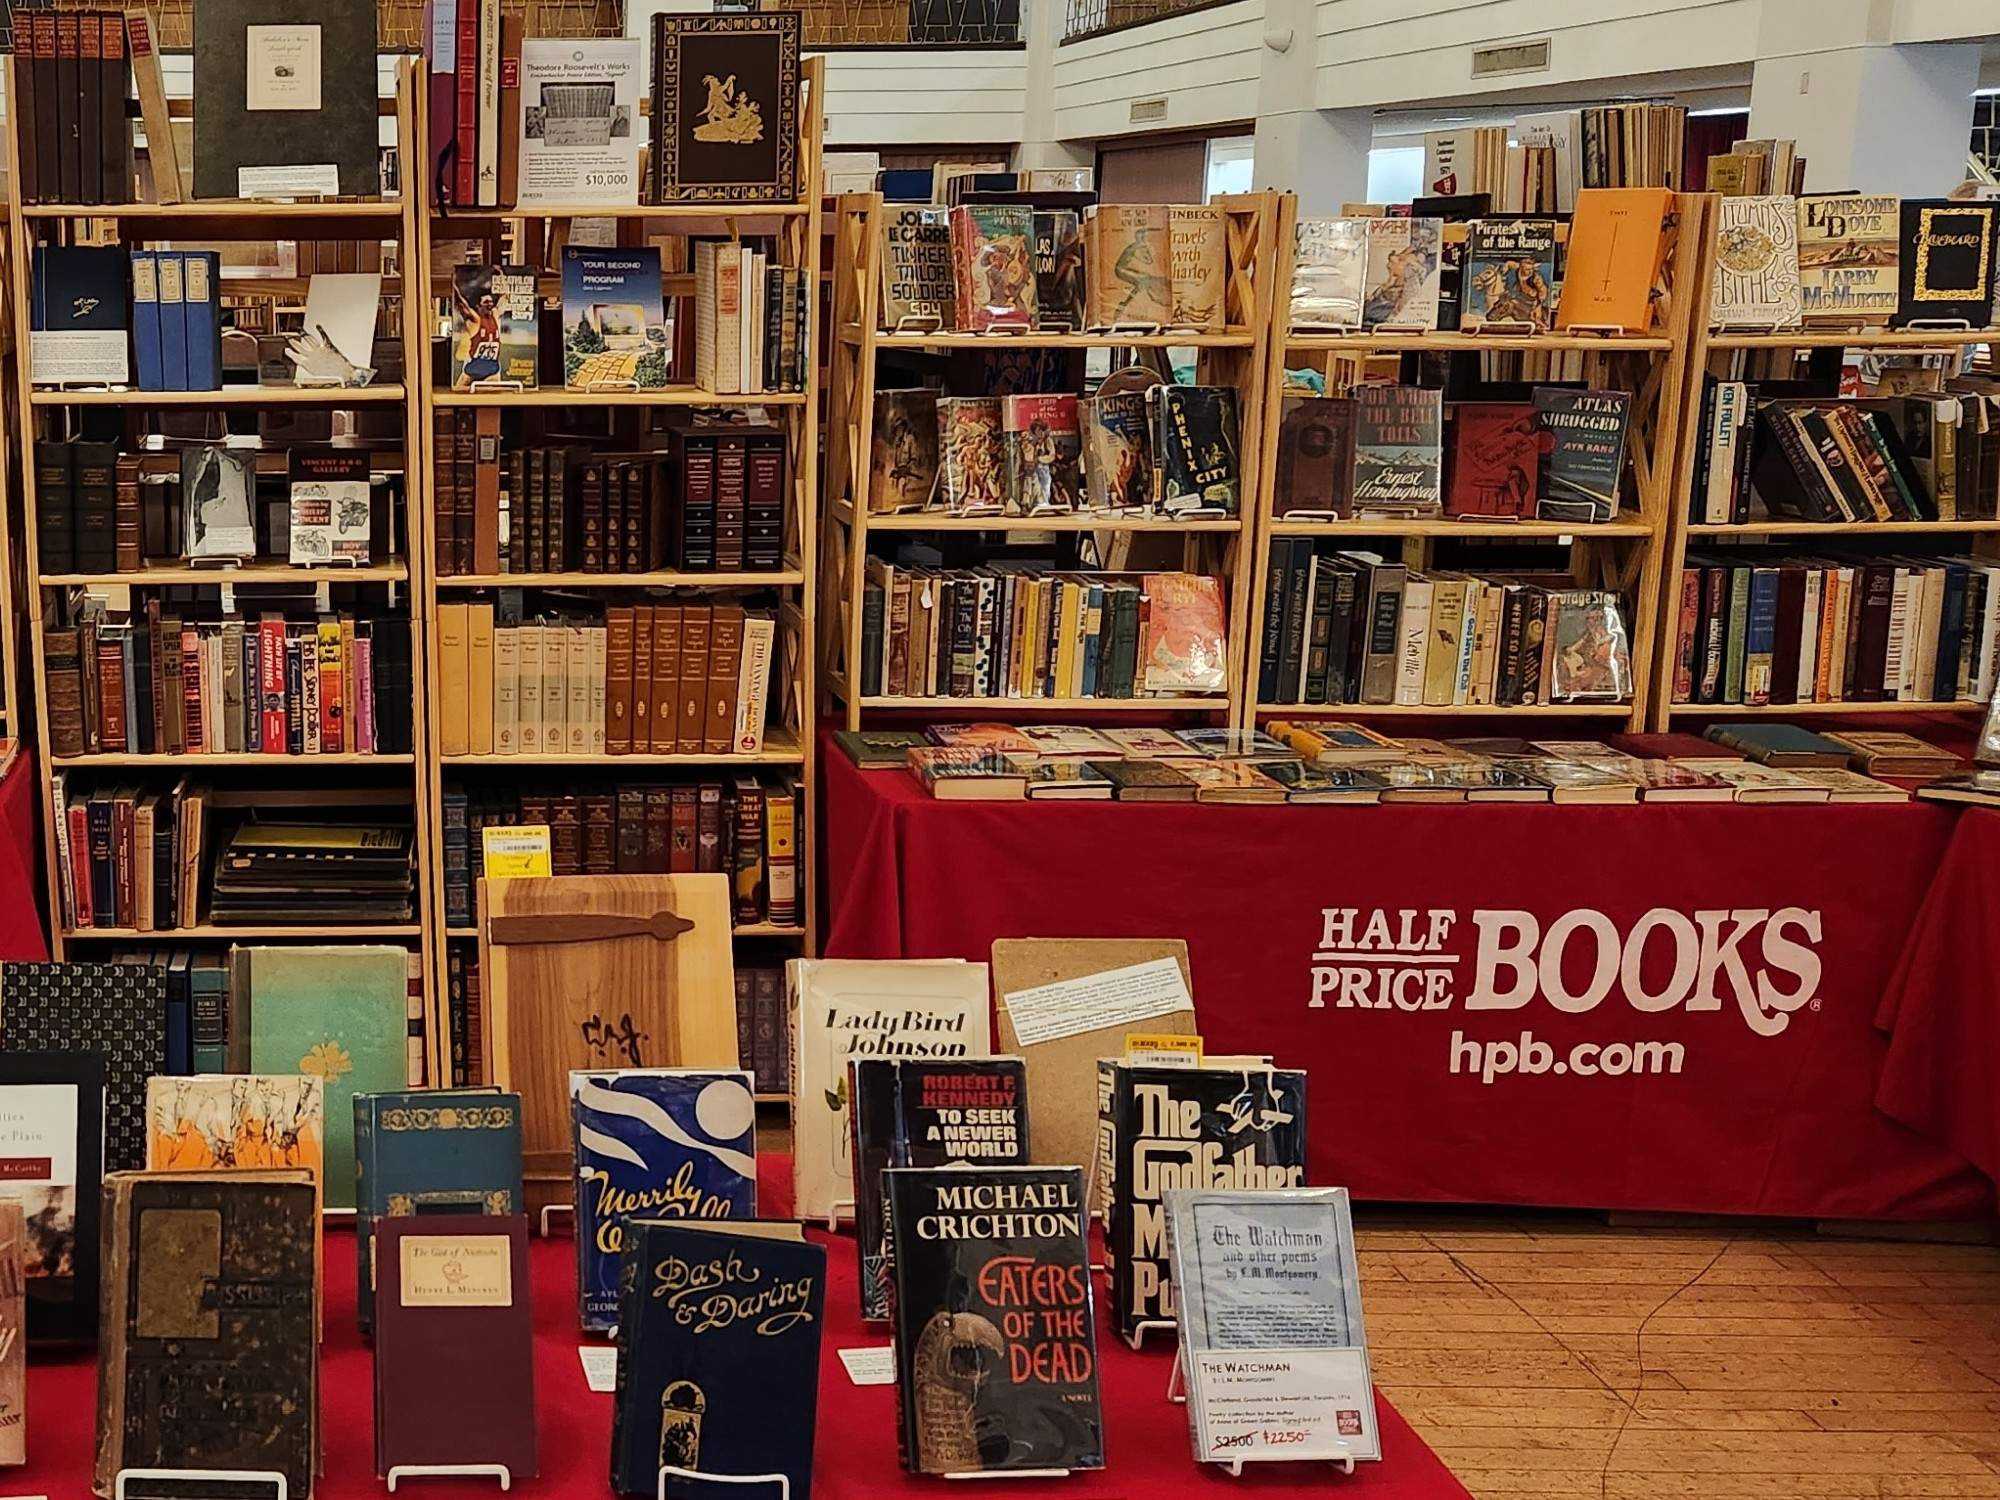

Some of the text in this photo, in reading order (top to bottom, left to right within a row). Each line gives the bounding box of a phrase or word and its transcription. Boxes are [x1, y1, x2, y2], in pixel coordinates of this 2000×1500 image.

[527, 63, 562, 71] Theodore
[563, 63, 605, 71] Roosevelt's
[585, 174, 628, 186] $10,000
[1805, 198, 1896, 228] LONESOME
[1172, 228, 1208, 244] ravels
[1475, 223, 1511, 236] Pirates
[1819, 214, 1882, 239] DOVE
[1482, 236, 1552, 251] of the Range
[583, 261, 641, 269] YOUR SECOND
[1172, 262, 1212, 283] harley
[583, 276, 625, 284] PROGRAM
[1822, 269, 1878, 290] LARRY
[892, 283, 956, 301] SOLDIER
[1571, 396, 1623, 413] ATLAS
[1365, 407, 1391, 424] THE
[1540, 412, 1621, 432] SHRUGGED
[1718, 386, 1735, 449] KEN FOLLETT
[1171, 402, 1199, 472] PHENIX
[1376, 425, 1423, 443] TOLLS
[1563, 442, 1585, 450] AYN
[1195, 466, 1229, 485] CITY
[1374, 466, 1424, 485] Ernest
[1353, 479, 1438, 502] Hemingway
[1273, 568, 1283, 588] Gone
[1269, 608, 1279, 623] the
[1466, 617, 1475, 637] God
[275, 636, 283, 657] PATH
[1464, 637, 1474, 659] Save
[1507, 602, 1522, 678] NEVER SO FEW
[263, 628, 274, 689] LIGHTNING
[1404, 627, 1423, 678] Melville
[1462, 659, 1472, 674] the
[304, 675, 319, 706] SIDNEY
[739, 804, 762, 813] GREAT
[743, 796, 758, 804] THE
[741, 813, 759, 821] WAR
[1318, 908, 1456, 950] HALF
[1465, 907, 1822, 1037] BOOKS
[1308, 967, 1454, 1011] PRICE
[824, 1008, 966, 1037] Lady Bird
[839, 1034, 966, 1056] Johnson
[1449, 1030, 1685, 1084] hpb.com
[922, 1075, 999, 1090] ROBERT
[922, 1091, 1016, 1107] KENNEDY
[937, 1109, 1017, 1124] TO SEEK
[1134, 1084, 1201, 1138] The
[12, 1129, 43, 1141] Plain
[926, 1125, 1017, 1141] A NEWER
[945, 1141, 1019, 1158] WORLD
[1096, 1069, 1117, 1234] The Godfather
[3, 1163, 42, 1173] McCarthy
[1132, 1140, 1303, 1200] Godfather
[587, 1160, 703, 1218] Merrily
[936, 1185, 1077, 1211] MICHAEL
[916, 1212, 1081, 1241] CRICHTON
[1213, 1224, 1323, 1248] The Watchman
[1222, 1252, 1318, 1266] and other poems
[651, 1249, 760, 1308] Dash
[977, 1256, 1086, 1308] EATERS
[1132, 1261, 1175, 1317] Pu
[674, 1276, 814, 1337] & Daring
[1004, 1308, 1085, 1340] OF THE
[1008, 1342, 1093, 1384] DEAD
[1201, 1362, 1291, 1373] THE WATCHMAN
